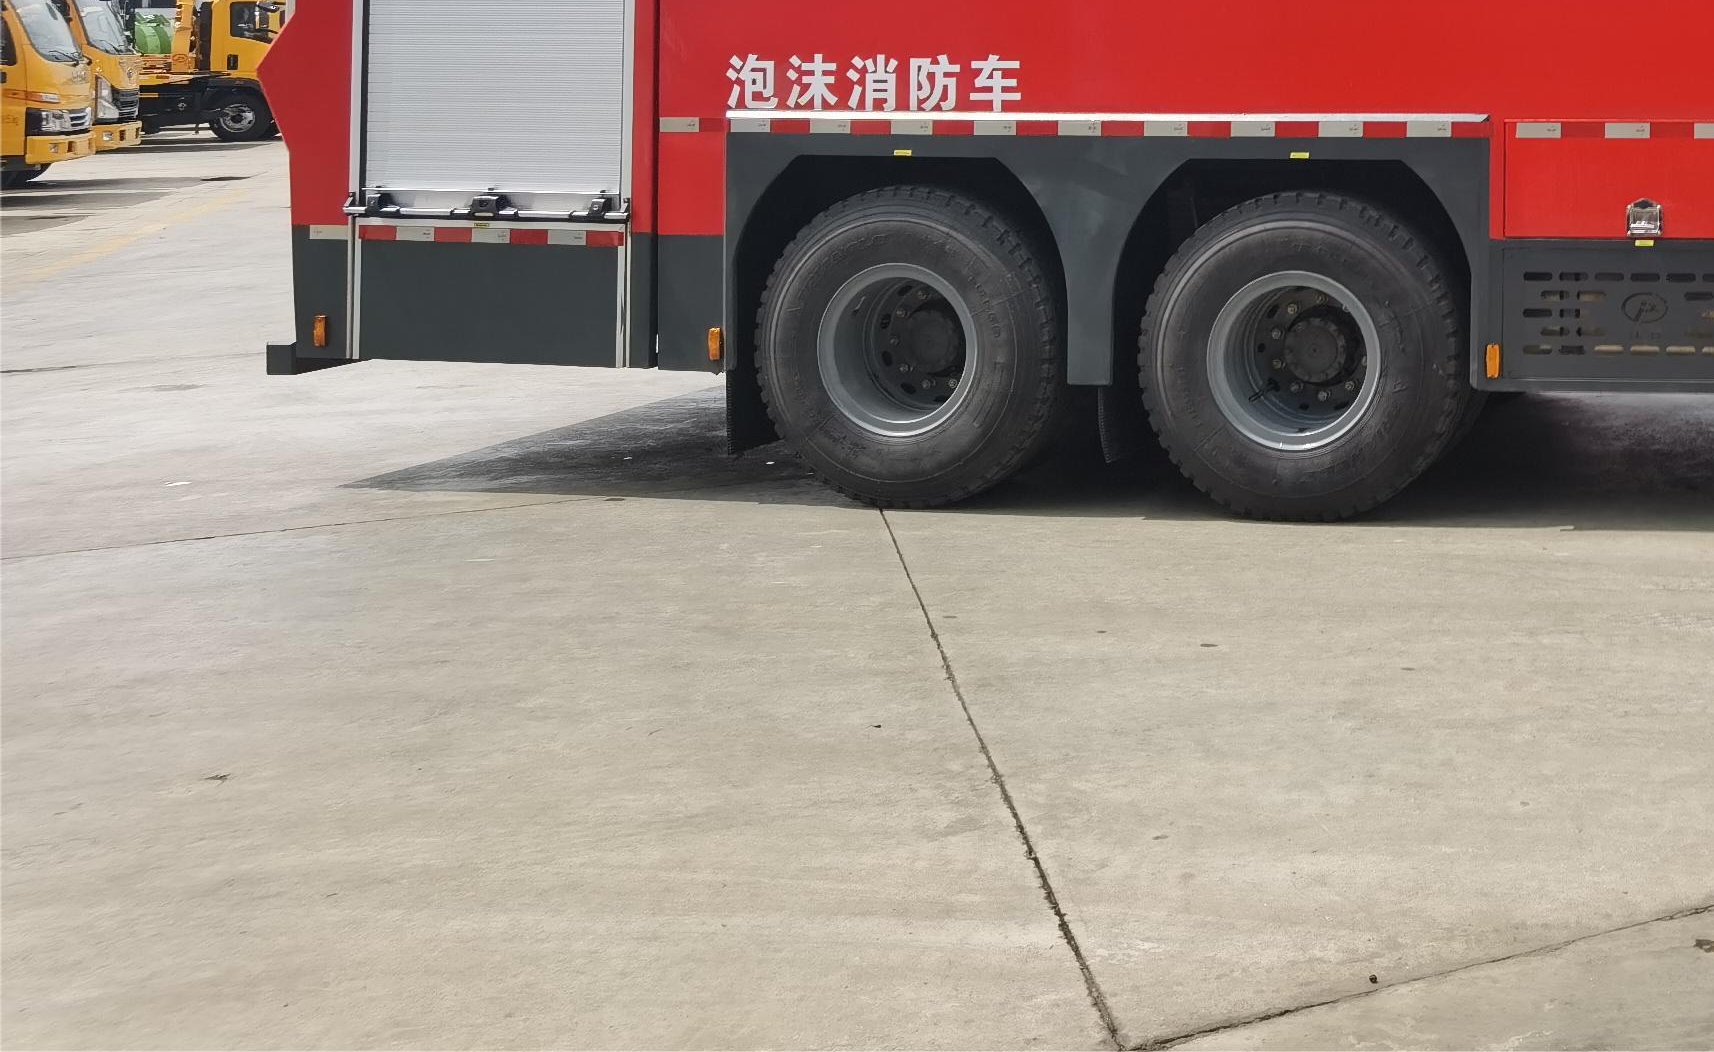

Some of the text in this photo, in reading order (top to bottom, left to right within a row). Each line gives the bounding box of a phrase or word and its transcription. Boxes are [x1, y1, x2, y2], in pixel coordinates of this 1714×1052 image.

[726, 53, 1021, 112] 泡沫消防车
